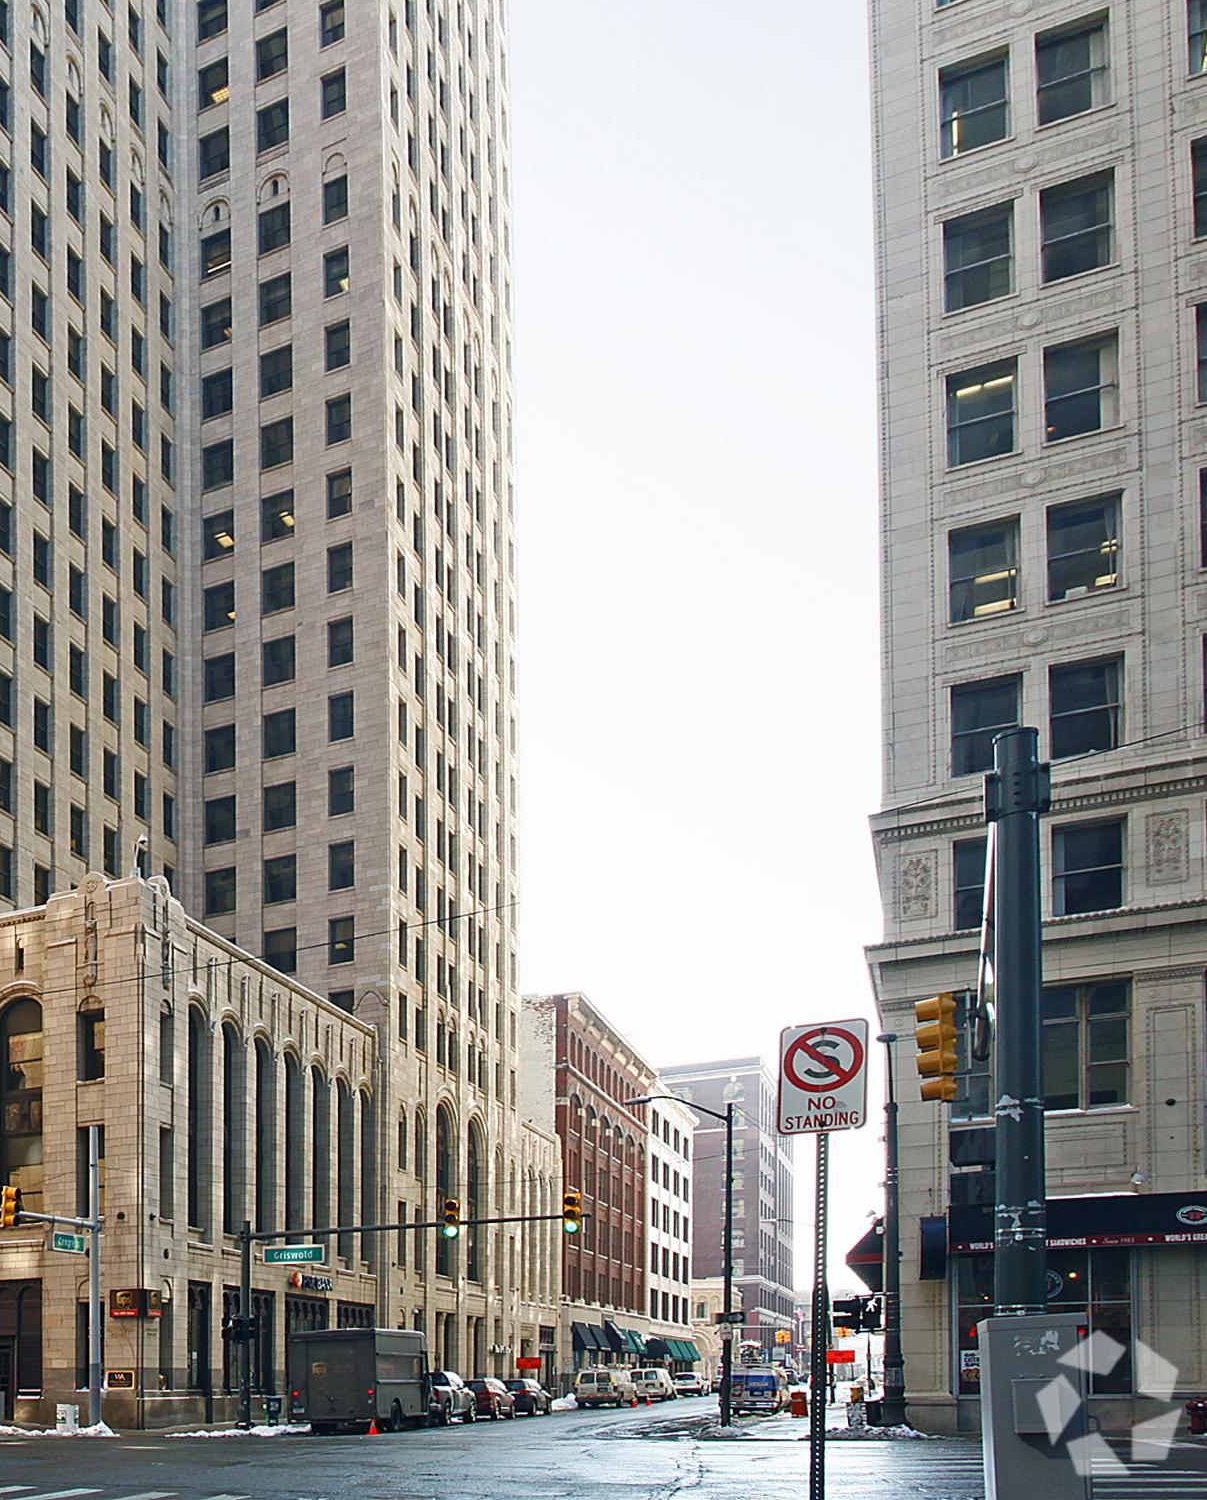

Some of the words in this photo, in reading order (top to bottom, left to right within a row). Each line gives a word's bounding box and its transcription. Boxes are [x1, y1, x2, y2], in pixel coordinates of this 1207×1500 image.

[808, 1096, 836, 1111] NO
[785, 1111, 859, 1130] STANDING
[1050, 1238, 1086, 1247] SANDWICHES
[1164, 1233, 1191, 1242] WORLD'S
[274, 1250, 313, 1260] Griswold
